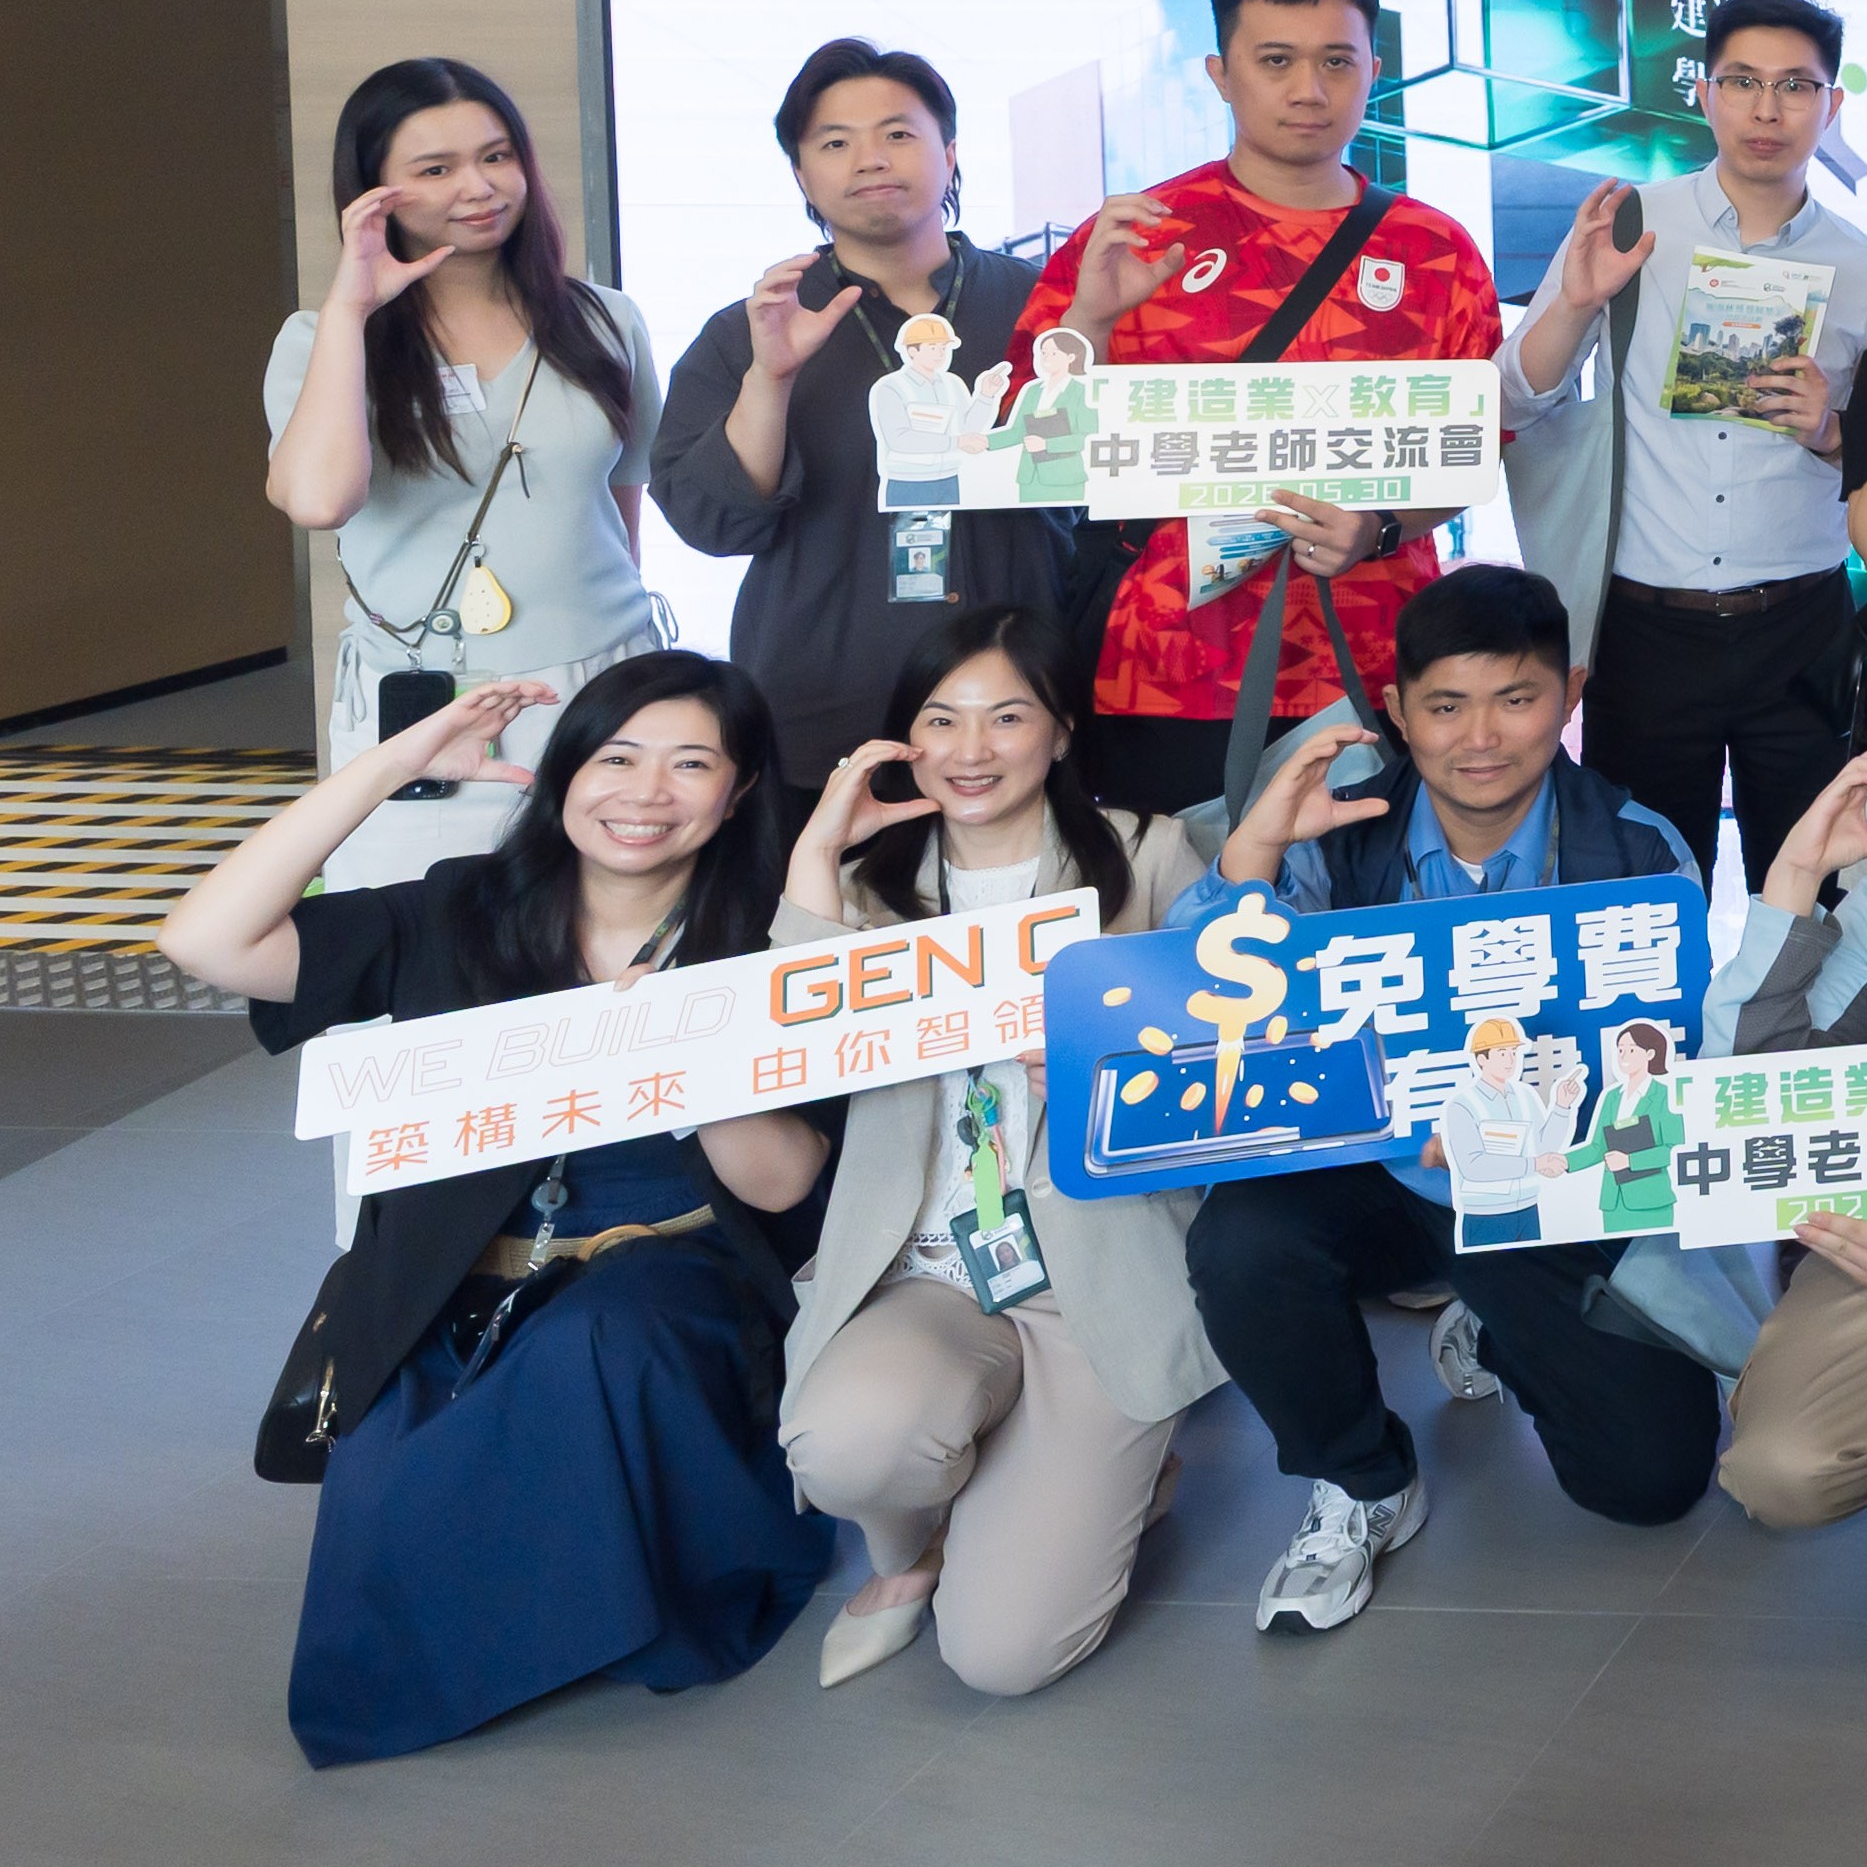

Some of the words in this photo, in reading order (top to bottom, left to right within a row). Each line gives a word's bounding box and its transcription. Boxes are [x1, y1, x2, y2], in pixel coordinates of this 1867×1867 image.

[1089, 424, 1484, 478] 中學老師交流會
[328, 1038, 463, 1111] WE
[486, 986, 737, 1081] BUILD
[769, 923, 986, 1029] GEN
[1315, 902, 1684, 1044] 免學費
[366, 1070, 687, 1177] 築構未來
[752, 995, 1045, 1095] 由你智領
